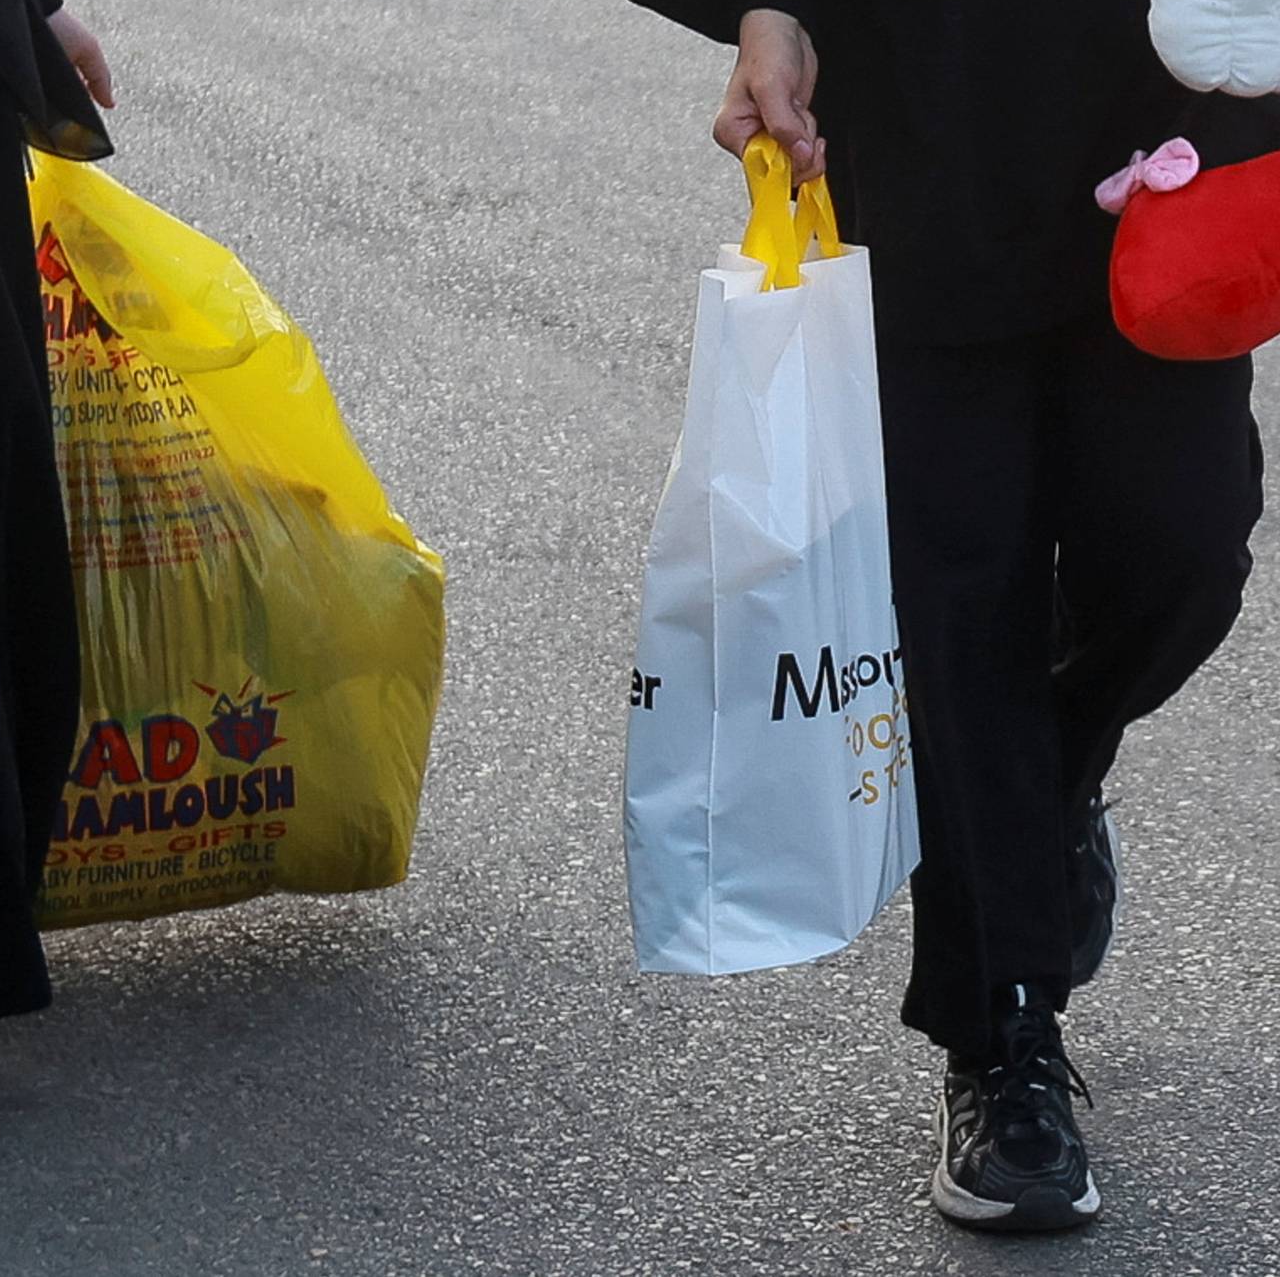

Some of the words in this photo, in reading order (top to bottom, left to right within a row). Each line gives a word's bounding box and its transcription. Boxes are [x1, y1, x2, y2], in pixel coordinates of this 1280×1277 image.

[48, 372, 69, 394] BY
[71, 713, 201, 790] AD
[43, 843, 126, 866] OYS
[168, 821, 288, 855] GIFTS
[77, 854, 185, 887] FURNITURE
[198, 840, 276, 870] BICYCLE
